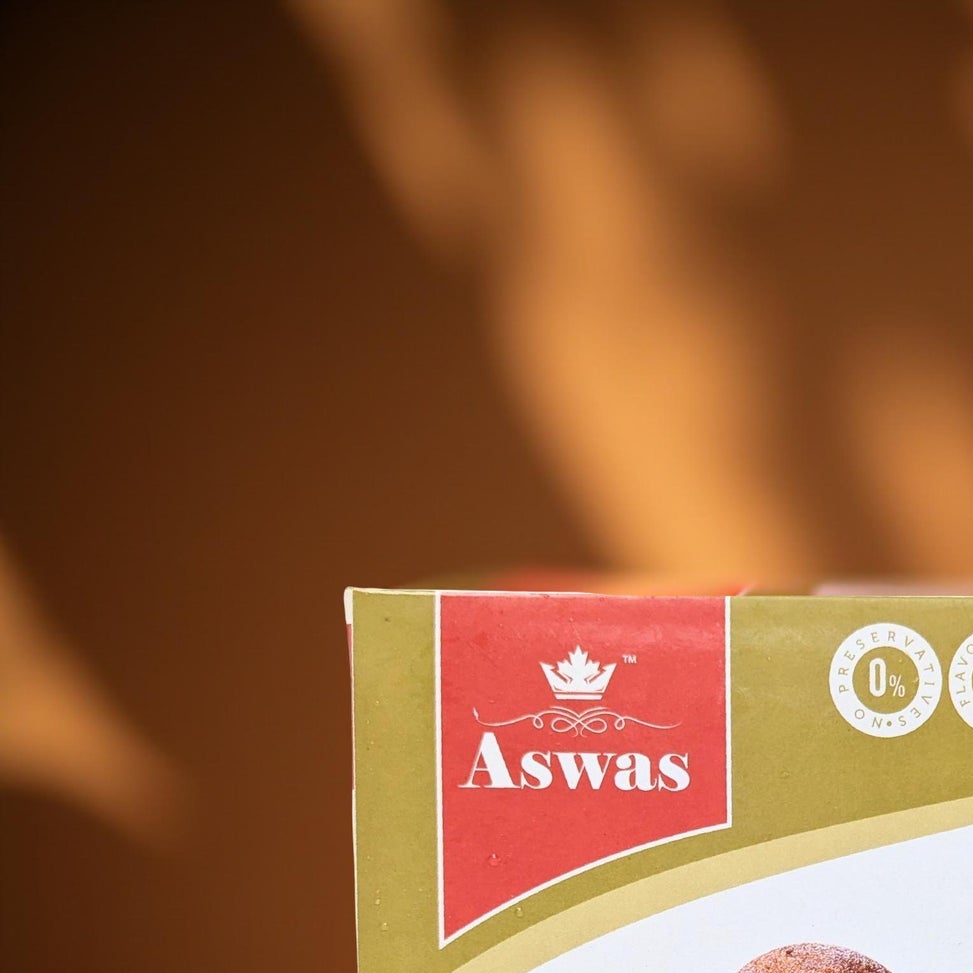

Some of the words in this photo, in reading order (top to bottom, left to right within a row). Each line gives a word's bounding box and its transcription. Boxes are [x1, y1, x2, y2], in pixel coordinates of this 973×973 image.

[838, 631, 935, 727] PRESERVATIVES
[869, 658, 905, 697] 0%
[854, 709, 883, 728] NO
[457, 731, 691, 792] Aswas
